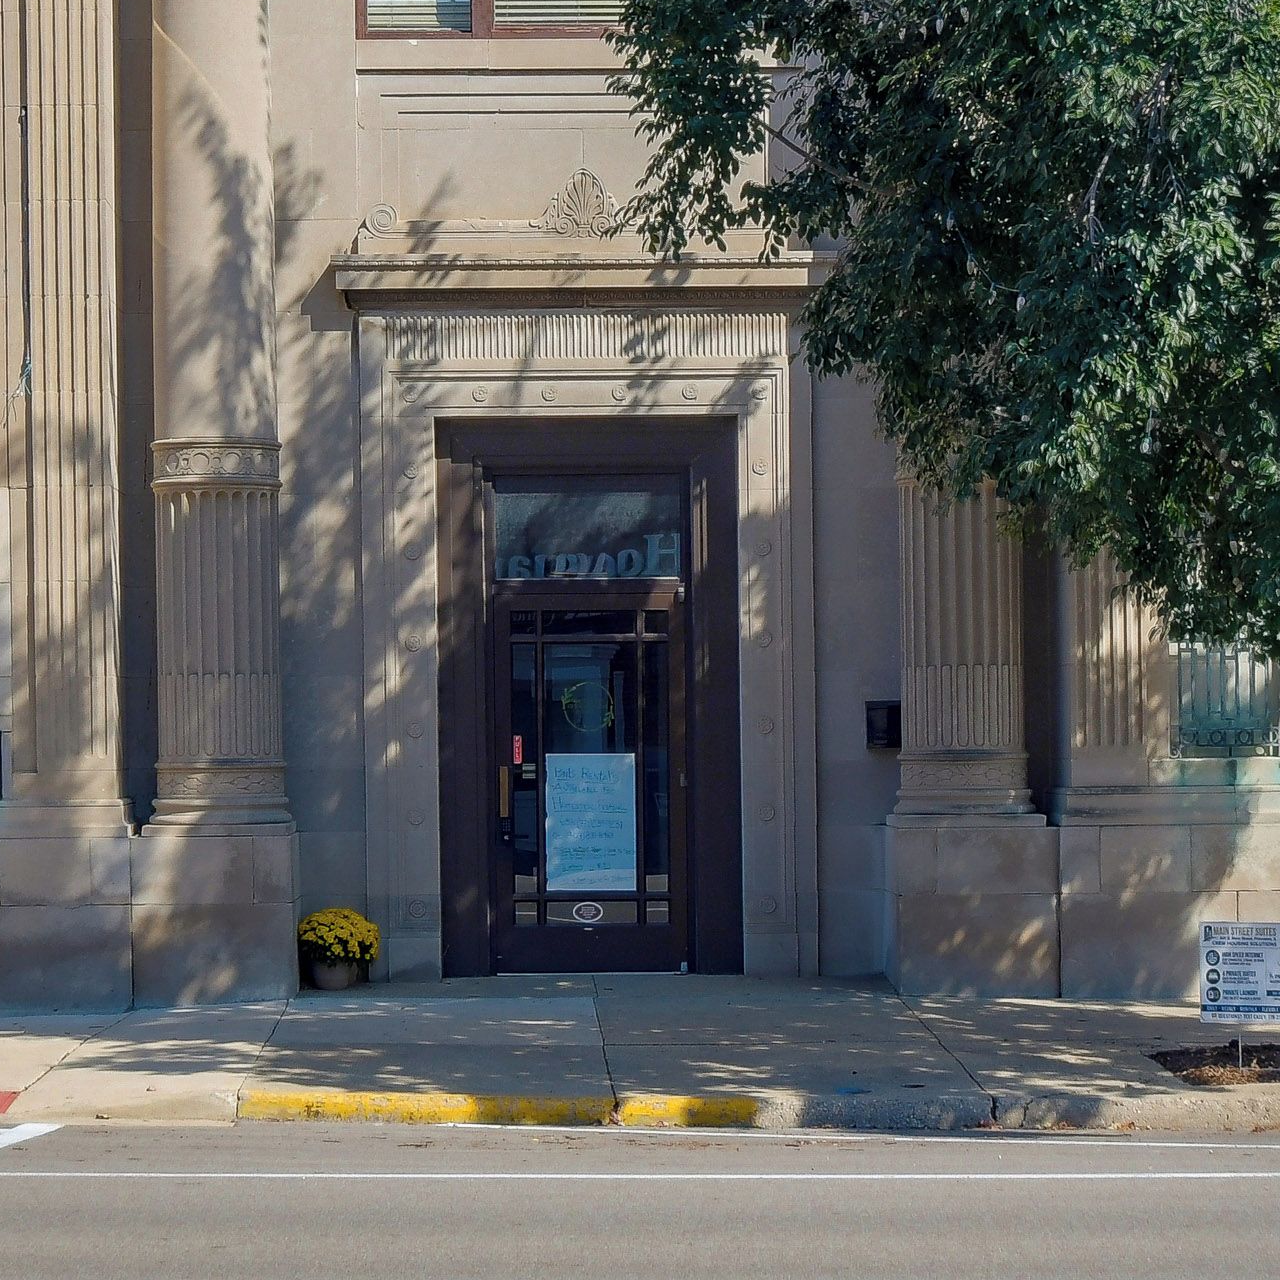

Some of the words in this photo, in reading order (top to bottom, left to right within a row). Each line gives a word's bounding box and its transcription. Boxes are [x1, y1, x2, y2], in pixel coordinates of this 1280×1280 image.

[1213, 926, 1229, 935] MAIN
[1231, 927, 1253, 936] STREET
[1255, 927, 1277, 936] SUITES
